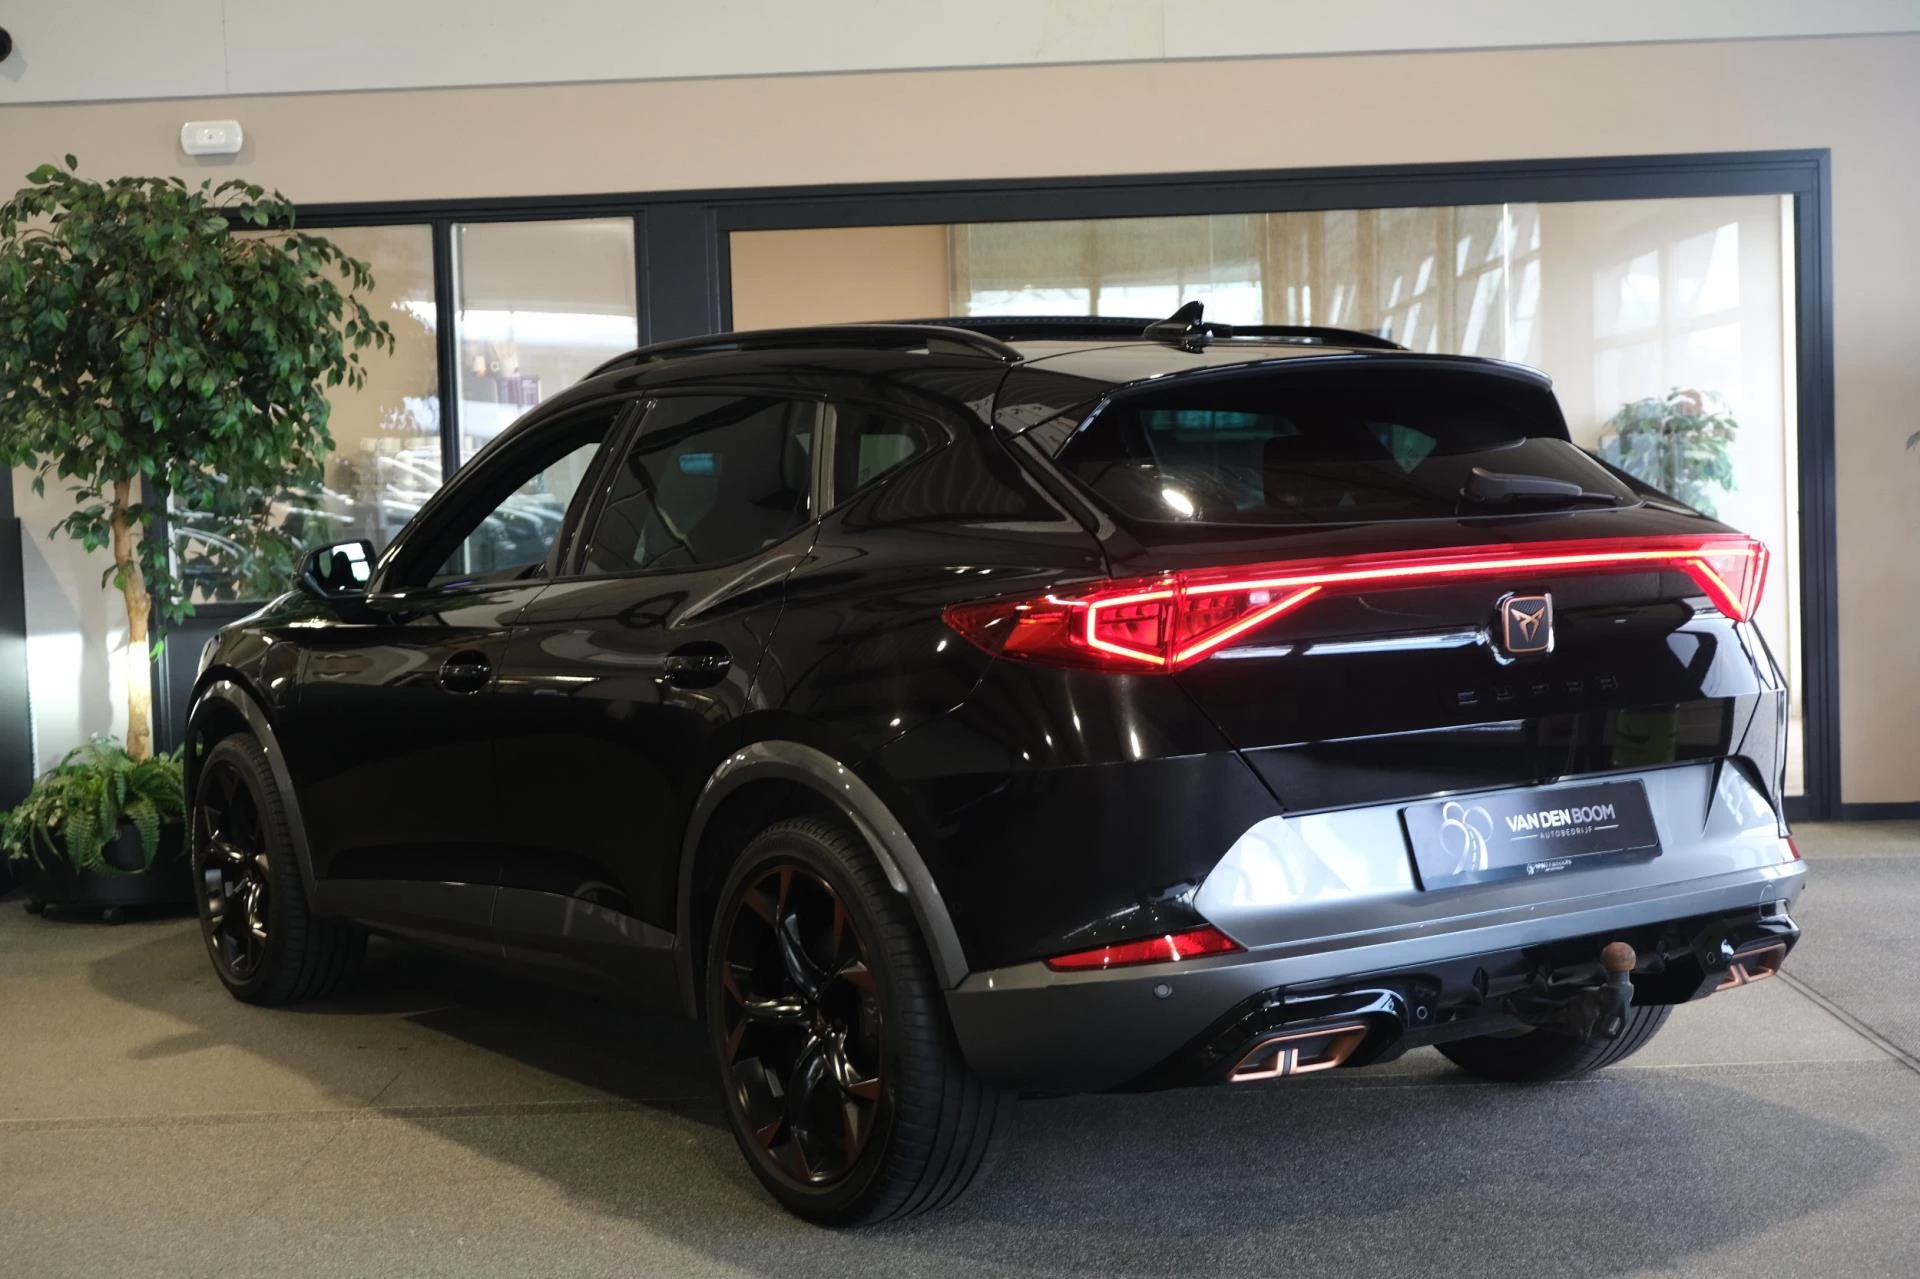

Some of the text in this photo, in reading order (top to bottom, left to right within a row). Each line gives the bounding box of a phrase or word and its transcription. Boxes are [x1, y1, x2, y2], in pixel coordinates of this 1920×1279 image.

[1505, 803, 1616, 832] VAN DEN BOOM
[1540, 826, 1593, 839] AUTOBEDRIJF
